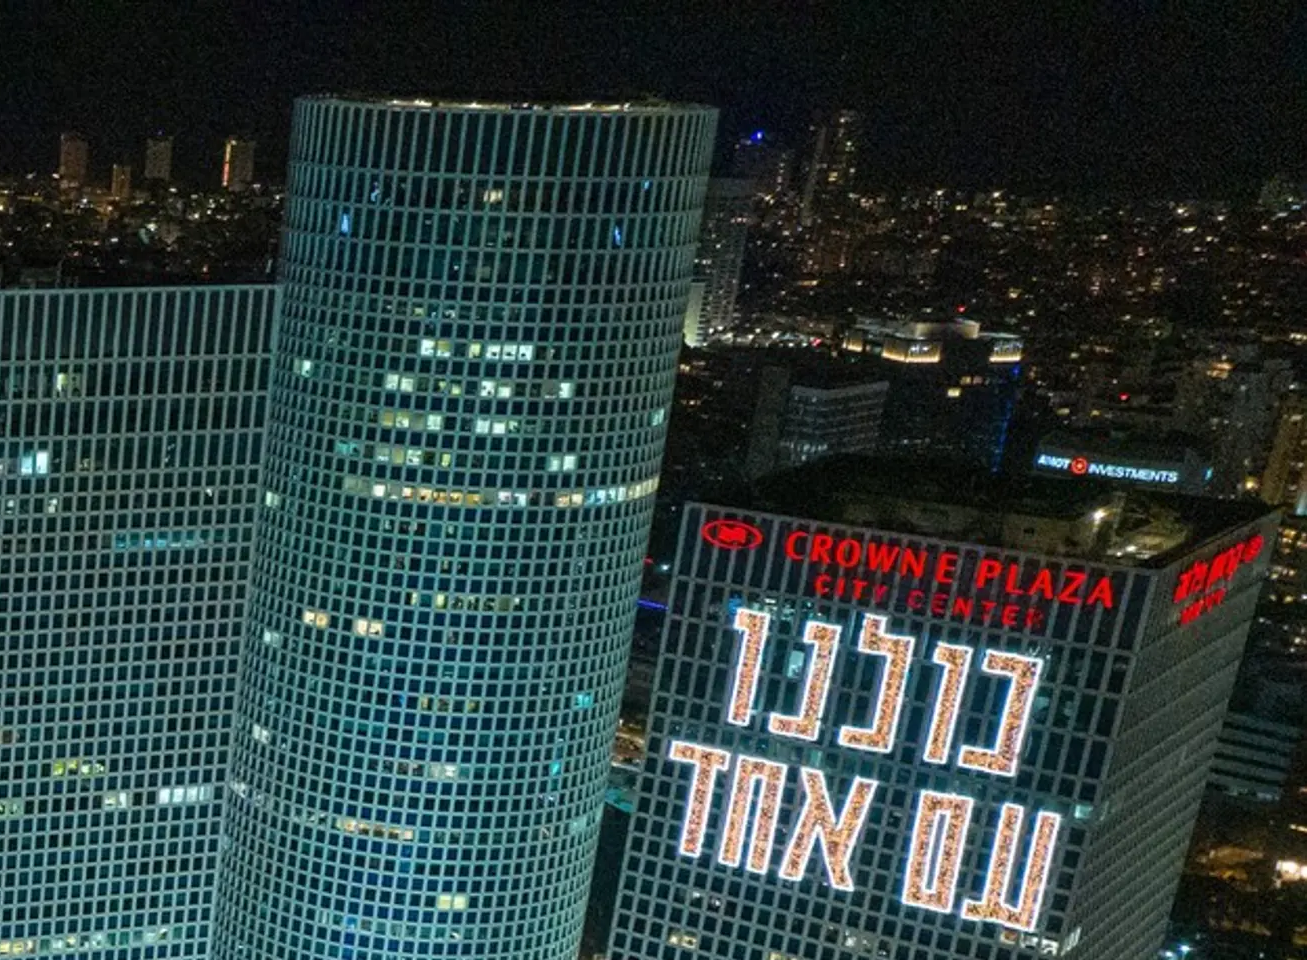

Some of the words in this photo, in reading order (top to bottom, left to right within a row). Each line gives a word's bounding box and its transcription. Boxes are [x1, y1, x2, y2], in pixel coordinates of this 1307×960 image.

[1088, 463, 1178, 482] INVESTMENTS
[785, 531, 959, 583] CROWNE
[976, 559, 1114, 609] PLAZA
[814, 573, 889, 604] CITY
[907, 590, 1043, 628] CENTER
[727, 607, 1043, 777] כולנו
[668, 740, 878, 892] אחד
[902, 788, 1061, 931] עם
